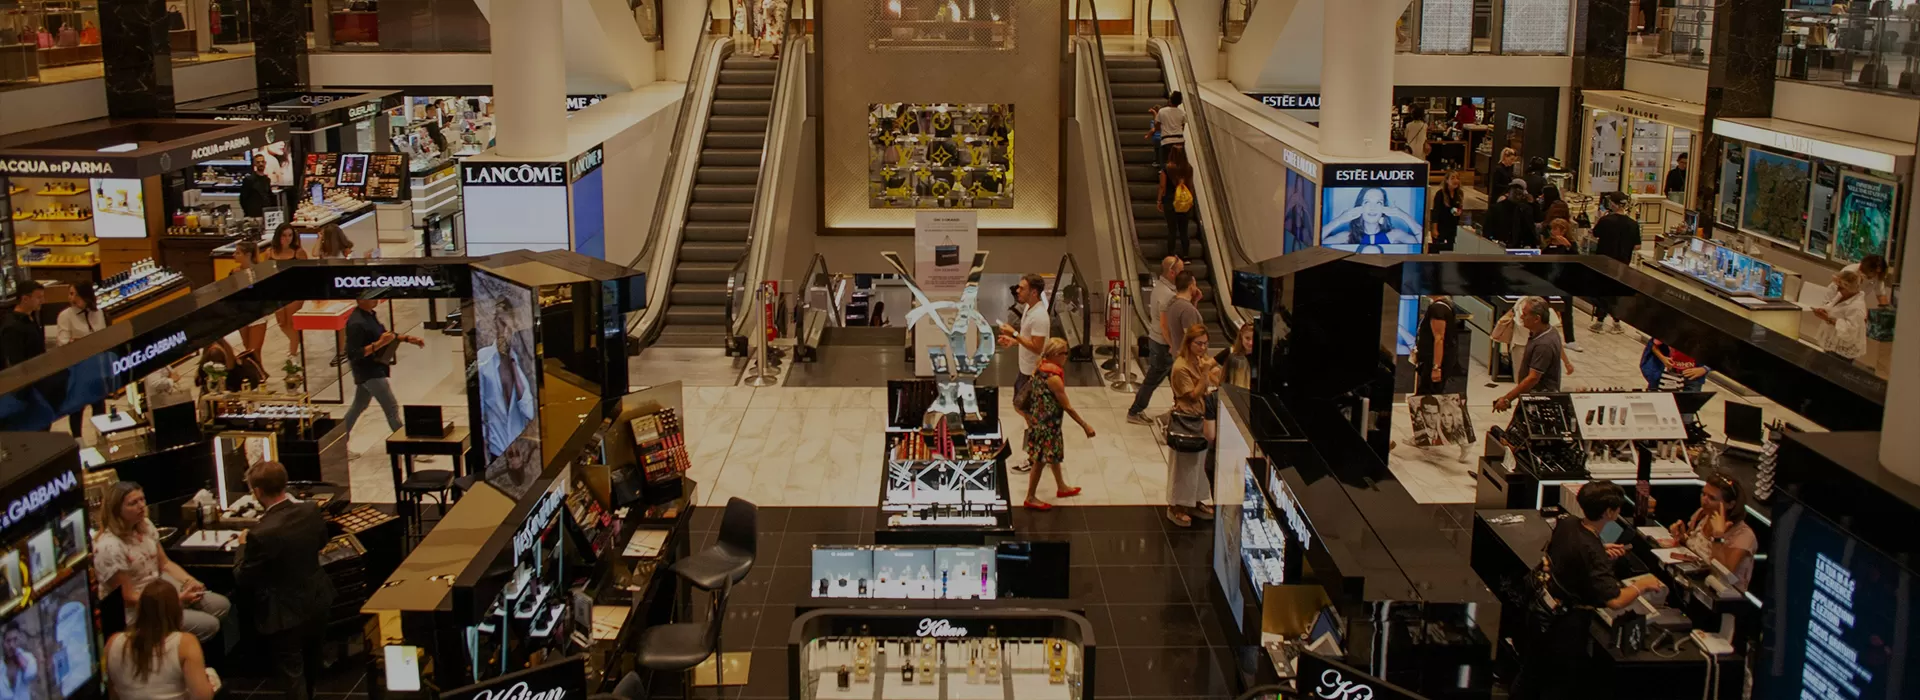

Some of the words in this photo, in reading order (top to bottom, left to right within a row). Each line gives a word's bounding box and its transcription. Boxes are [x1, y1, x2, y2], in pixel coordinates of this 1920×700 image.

[191, 144, 219, 160] ACQUA
[224, 136, 251, 151] PARMA
[0, 160, 49, 173] ACQUA
[62, 161, 113, 174] PARMA
[465, 164, 564, 183] LANCÔME
[1370, 170, 1414, 180] LAUDER
[916, 617, 968, 637] Kilian
